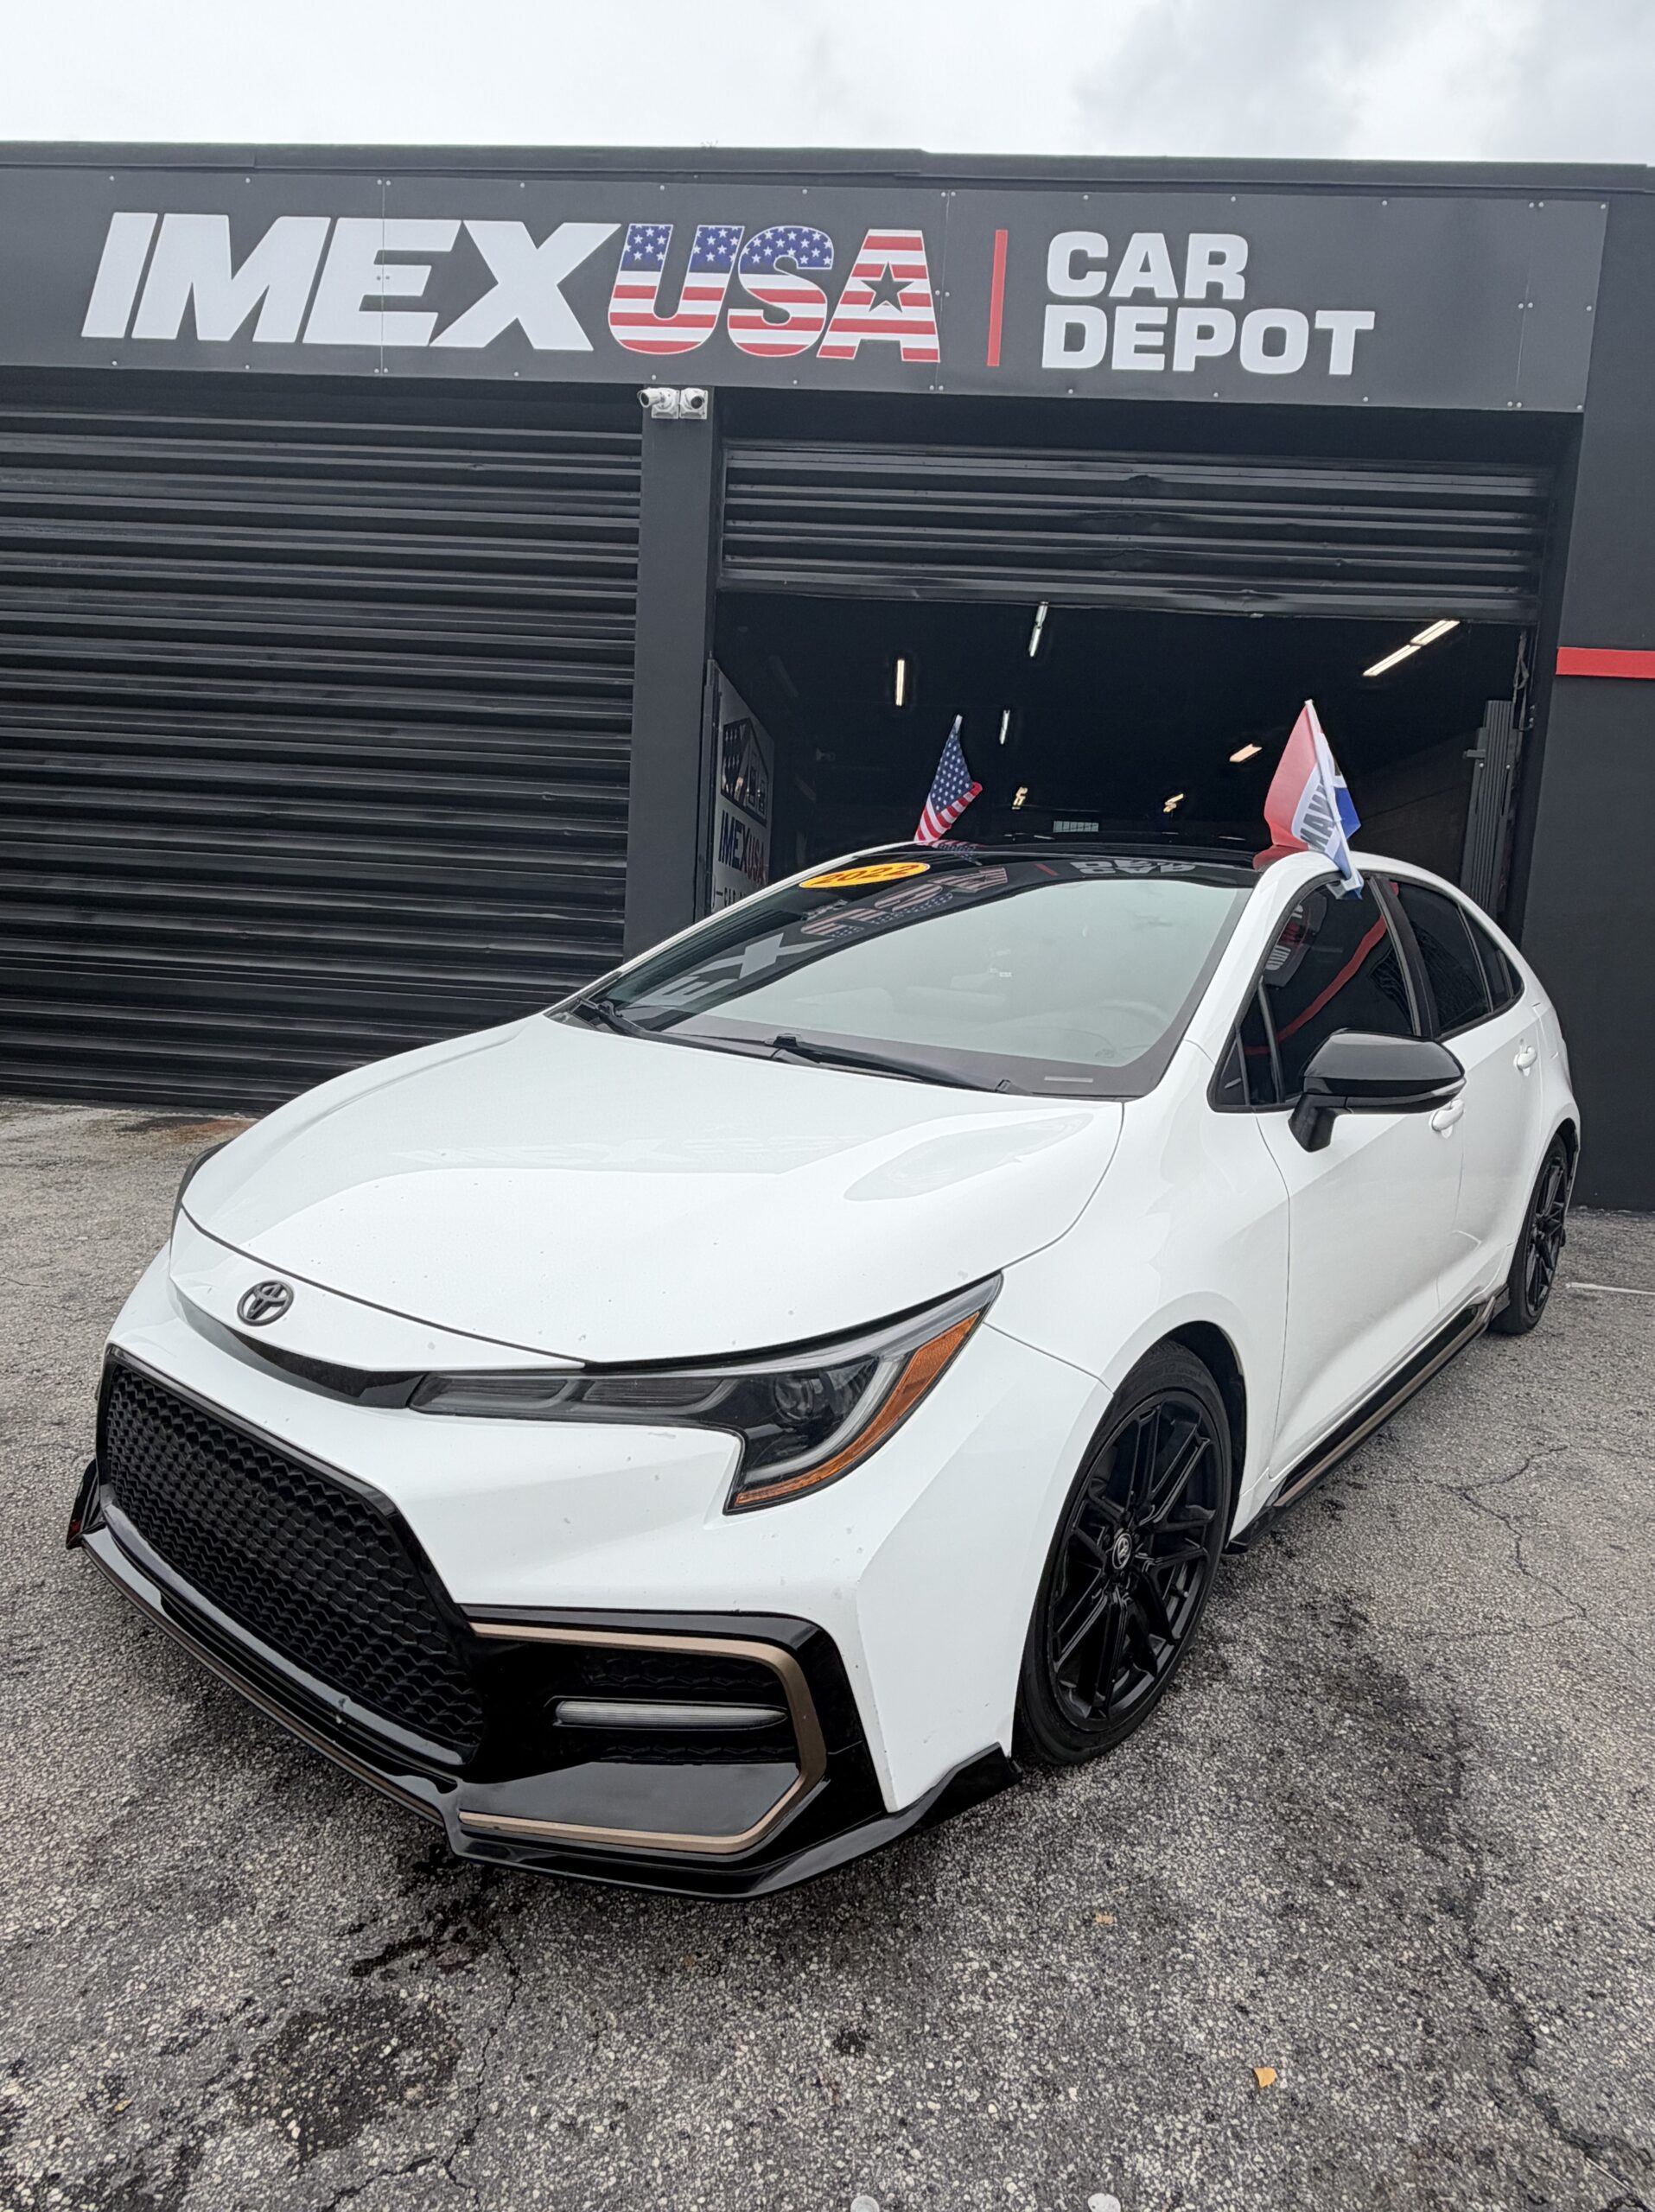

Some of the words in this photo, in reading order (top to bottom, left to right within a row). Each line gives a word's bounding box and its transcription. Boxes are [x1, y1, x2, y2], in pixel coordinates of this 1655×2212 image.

[1046, 231, 1249, 300] CAR
[1041, 304, 1376, 376] DEPOT
[811, 864, 920, 886] 2022
